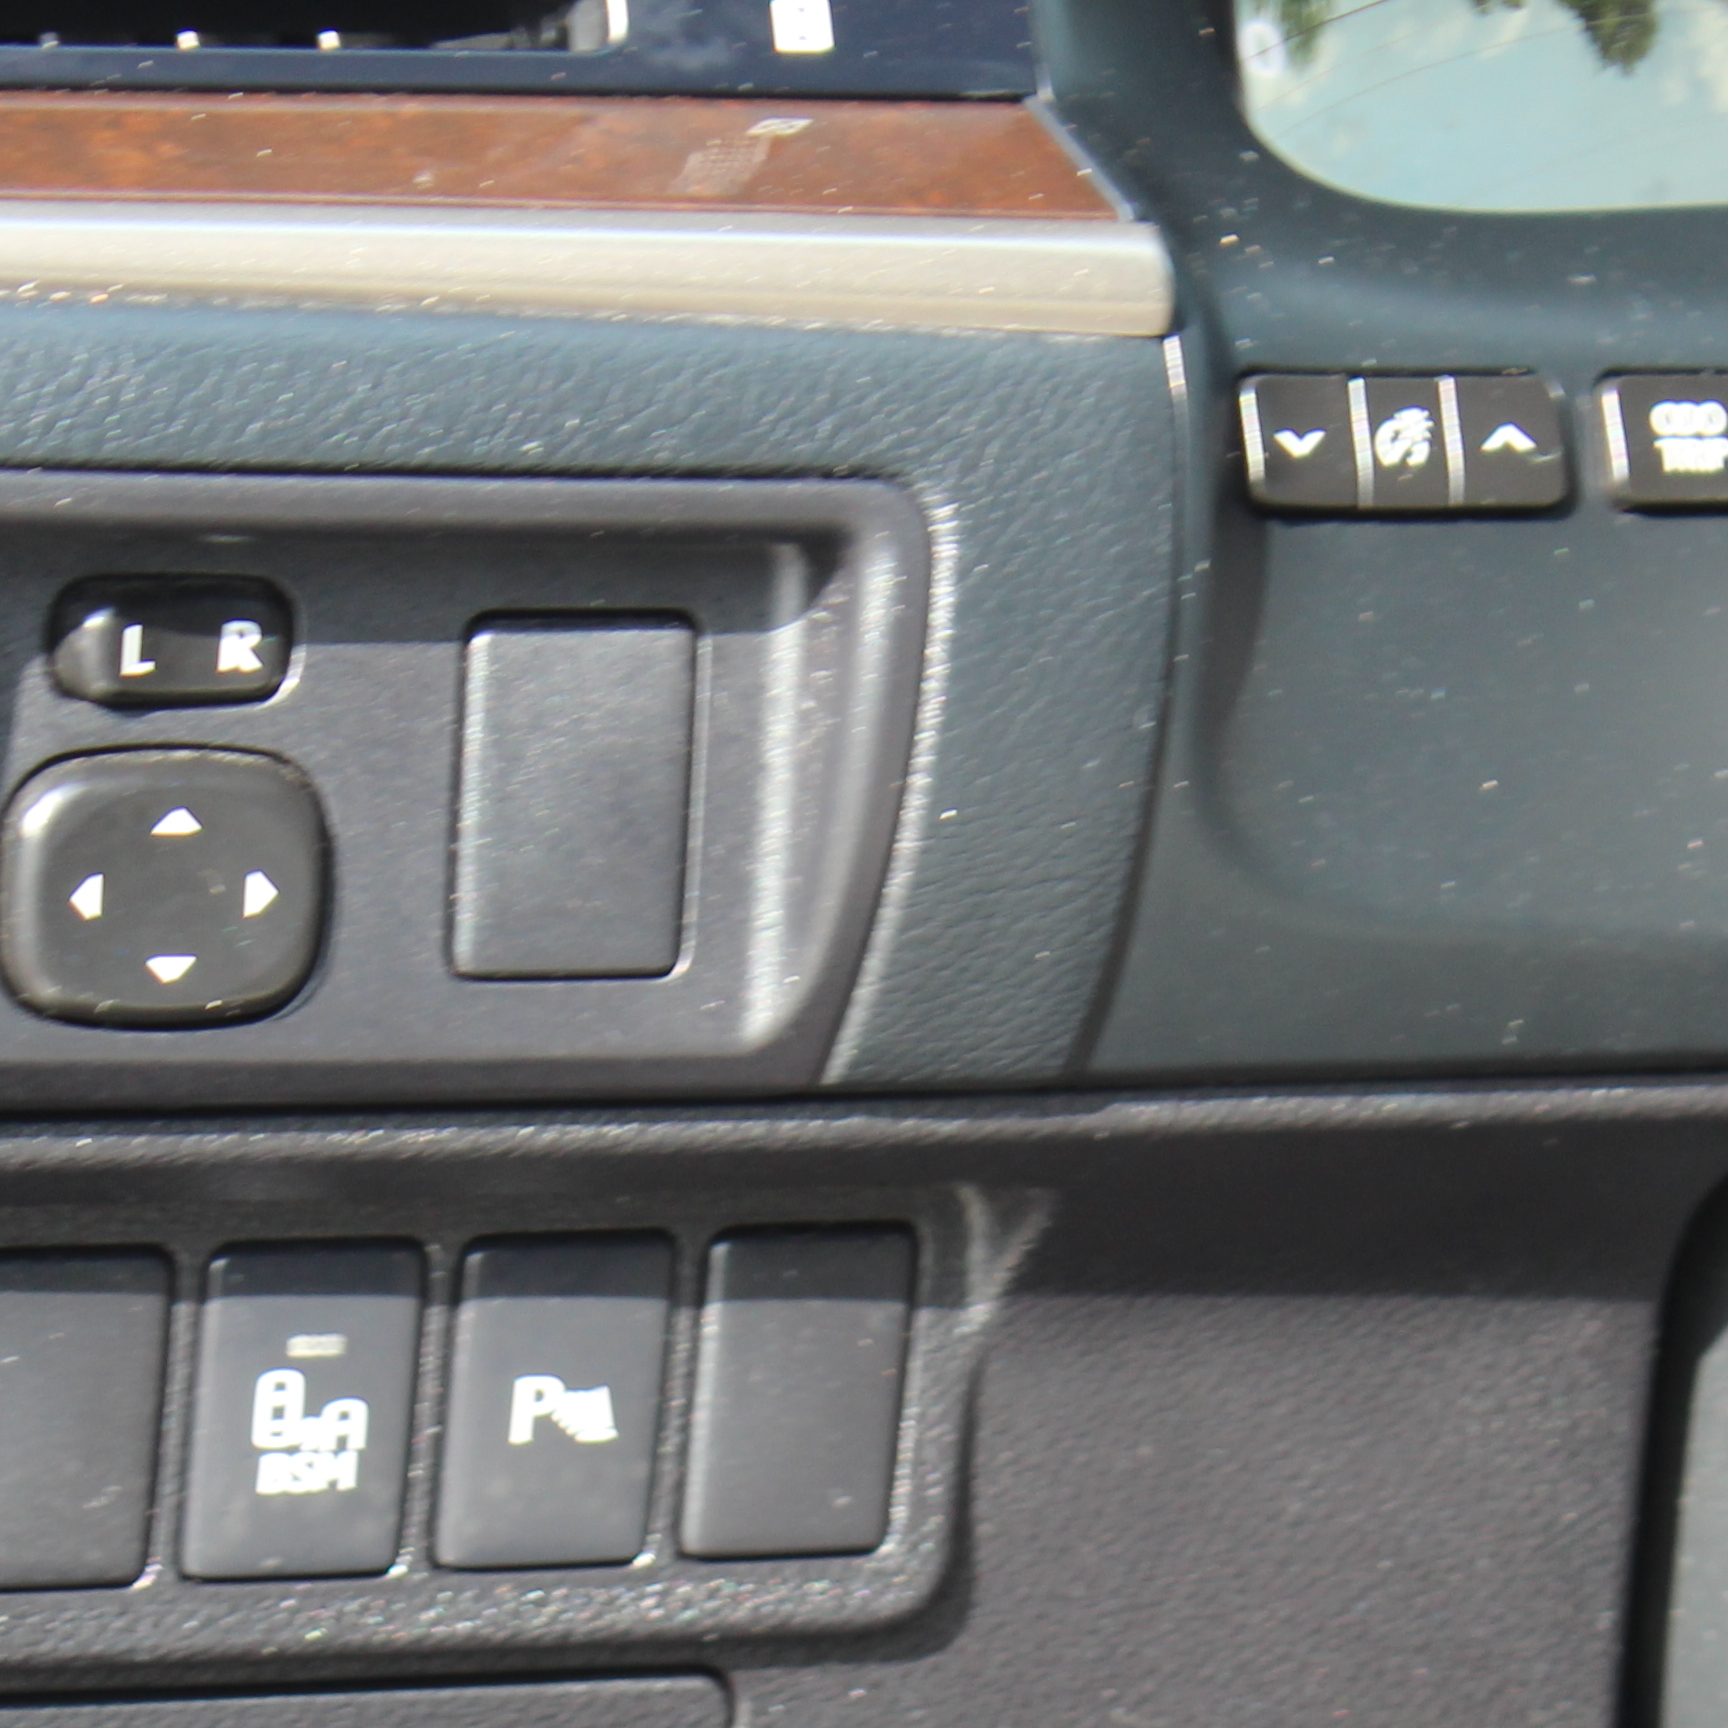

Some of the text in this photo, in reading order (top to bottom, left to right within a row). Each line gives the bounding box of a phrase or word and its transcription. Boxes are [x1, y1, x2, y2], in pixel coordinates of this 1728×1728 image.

[1649, 400, 1728, 436] ODO
[120, 620, 264, 677] L R
[255, 1450, 358, 1495] BSM
